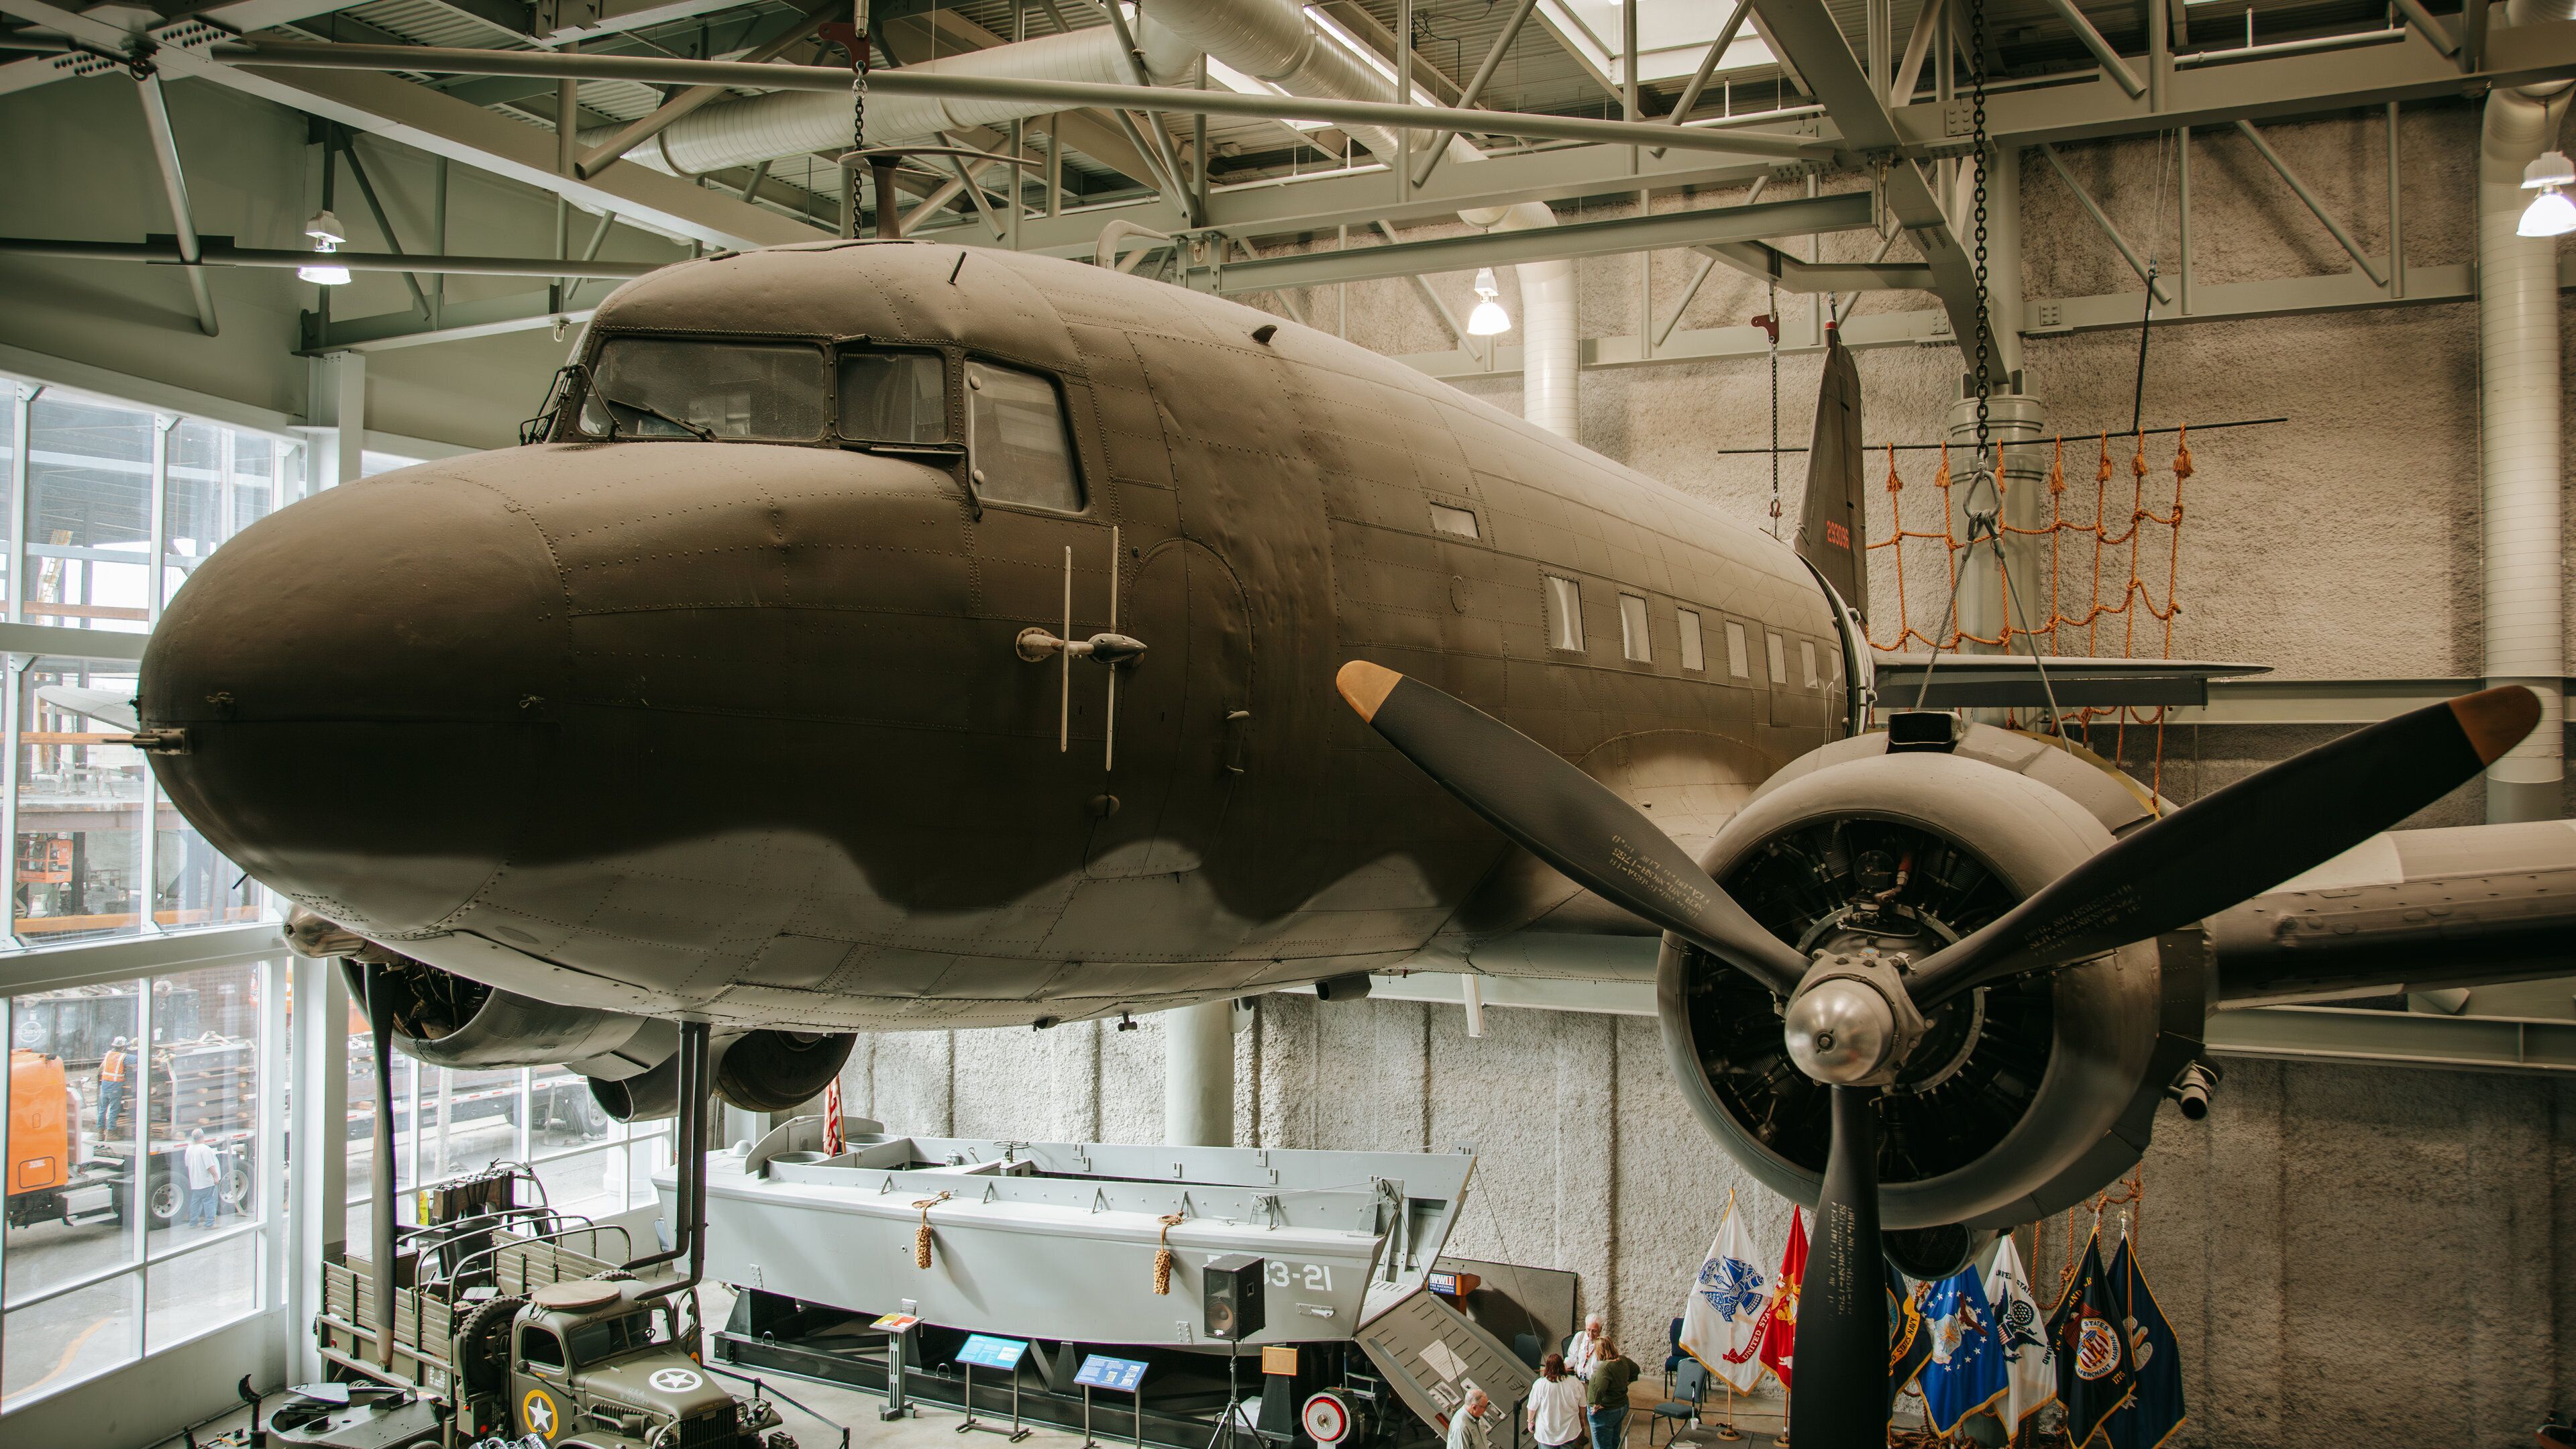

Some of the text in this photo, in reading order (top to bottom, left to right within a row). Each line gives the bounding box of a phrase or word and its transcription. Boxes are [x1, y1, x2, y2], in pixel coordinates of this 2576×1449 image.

[1827, 520, 1849, 550] 293096
[1264, 1260, 1332, 1291] 3-21
[1742, 1307, 1771, 1359] UNITED STAT
[1896, 1317, 1917, 1354] STATES NAVY
[2084, 1320, 2109, 1332] STATES
[2078, 1334, 2118, 1378] MERCHANT MARINE
[2112, 1371, 2126, 1385] 1775
